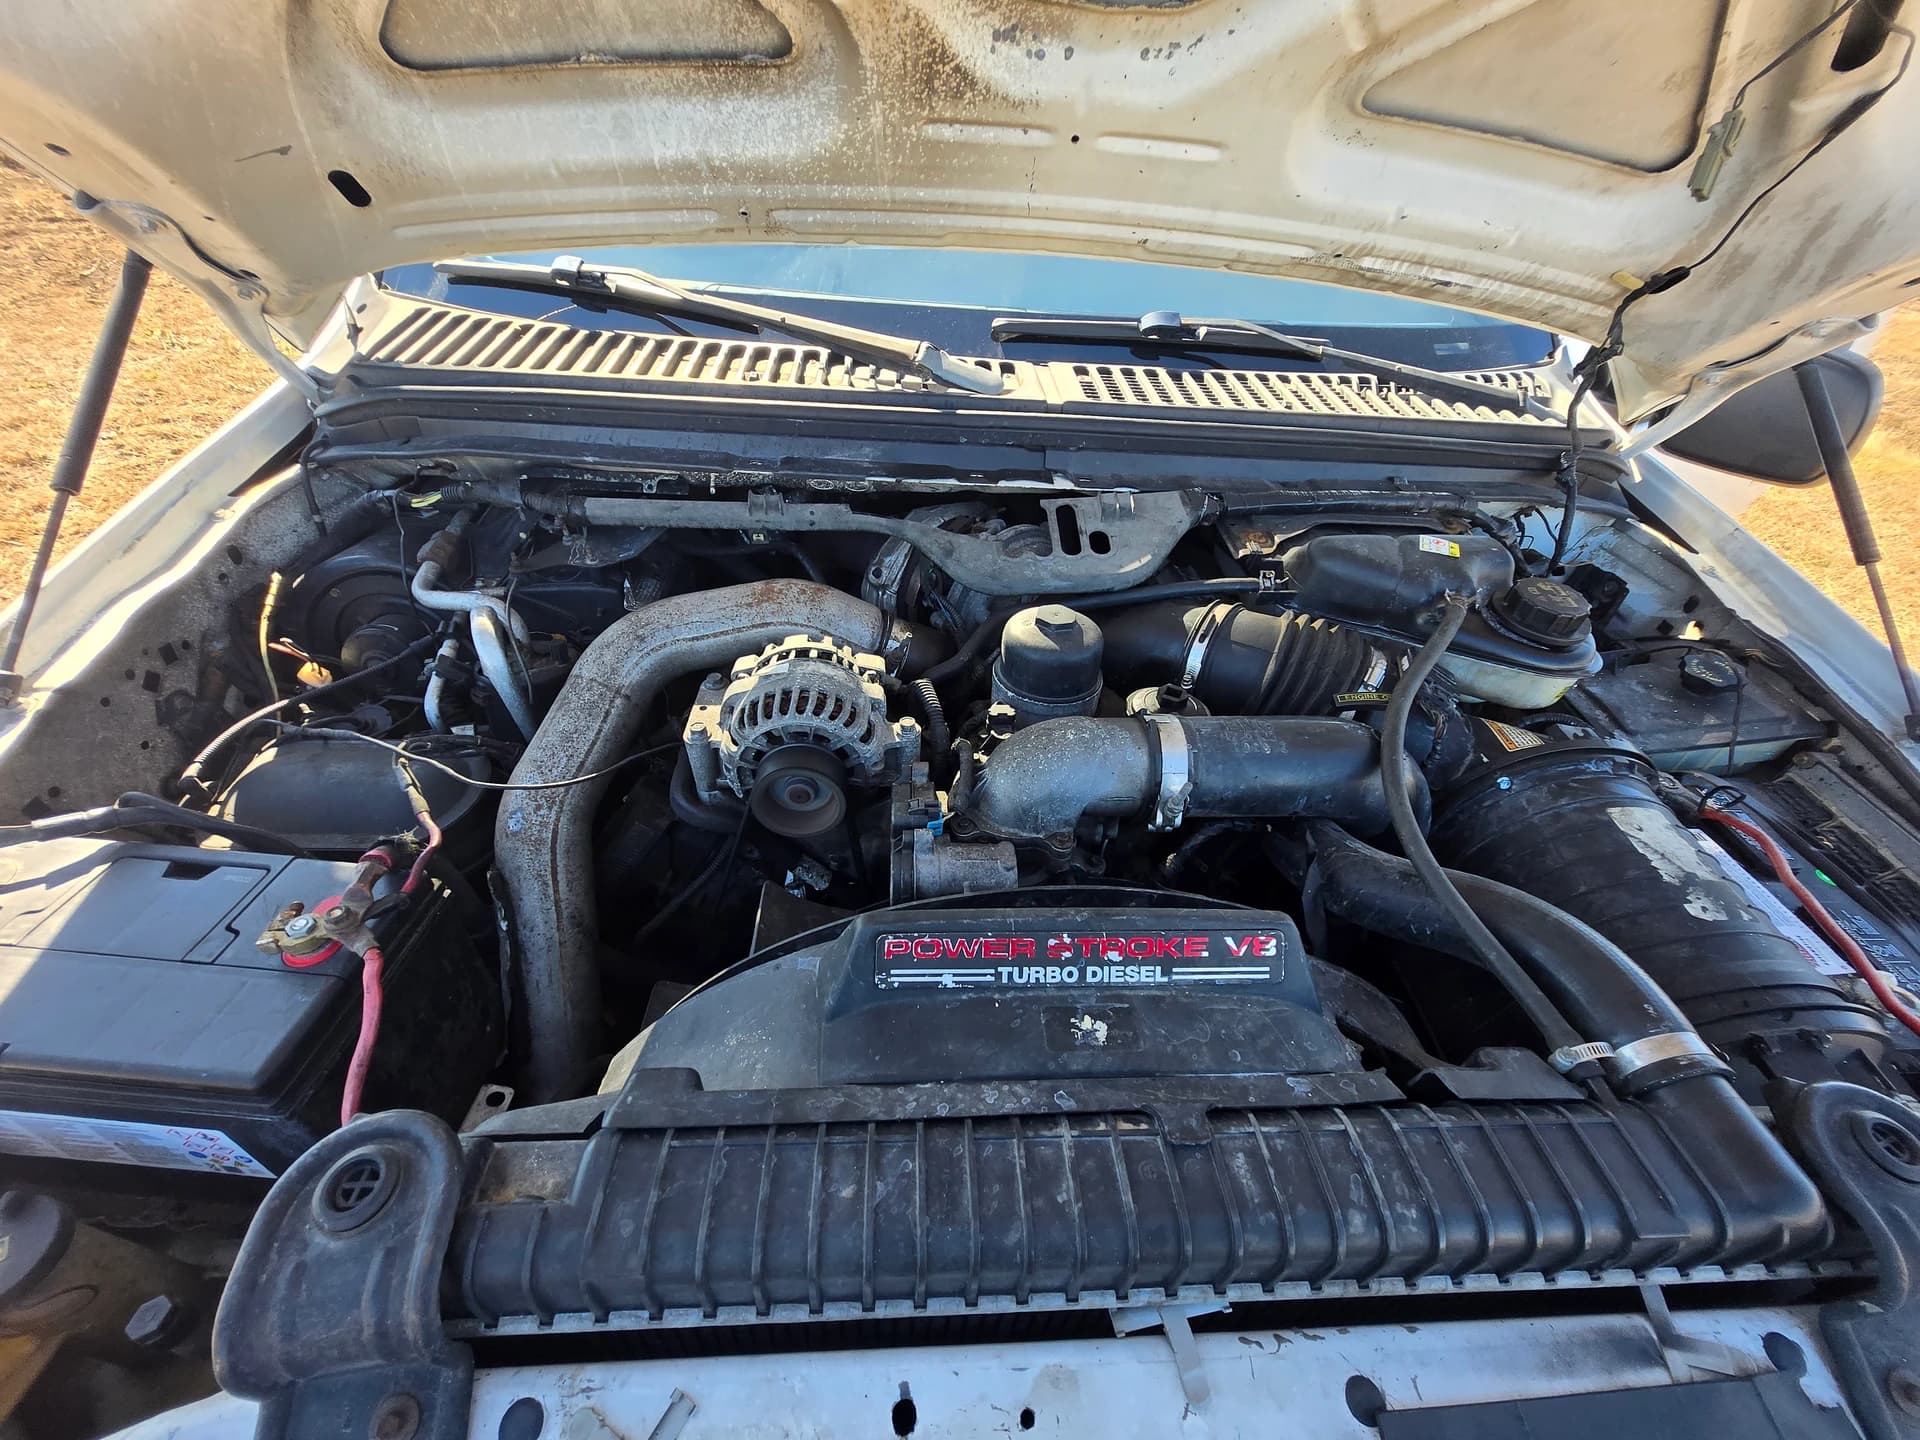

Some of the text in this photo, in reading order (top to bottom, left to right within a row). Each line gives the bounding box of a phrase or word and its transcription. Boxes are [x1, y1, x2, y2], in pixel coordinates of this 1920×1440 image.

[1344, 693, 1378, 701] ENGINE
[884, 936, 1277, 960] POWER STROKE V8
[998, 965, 1169, 984] TURBO DIESEL
